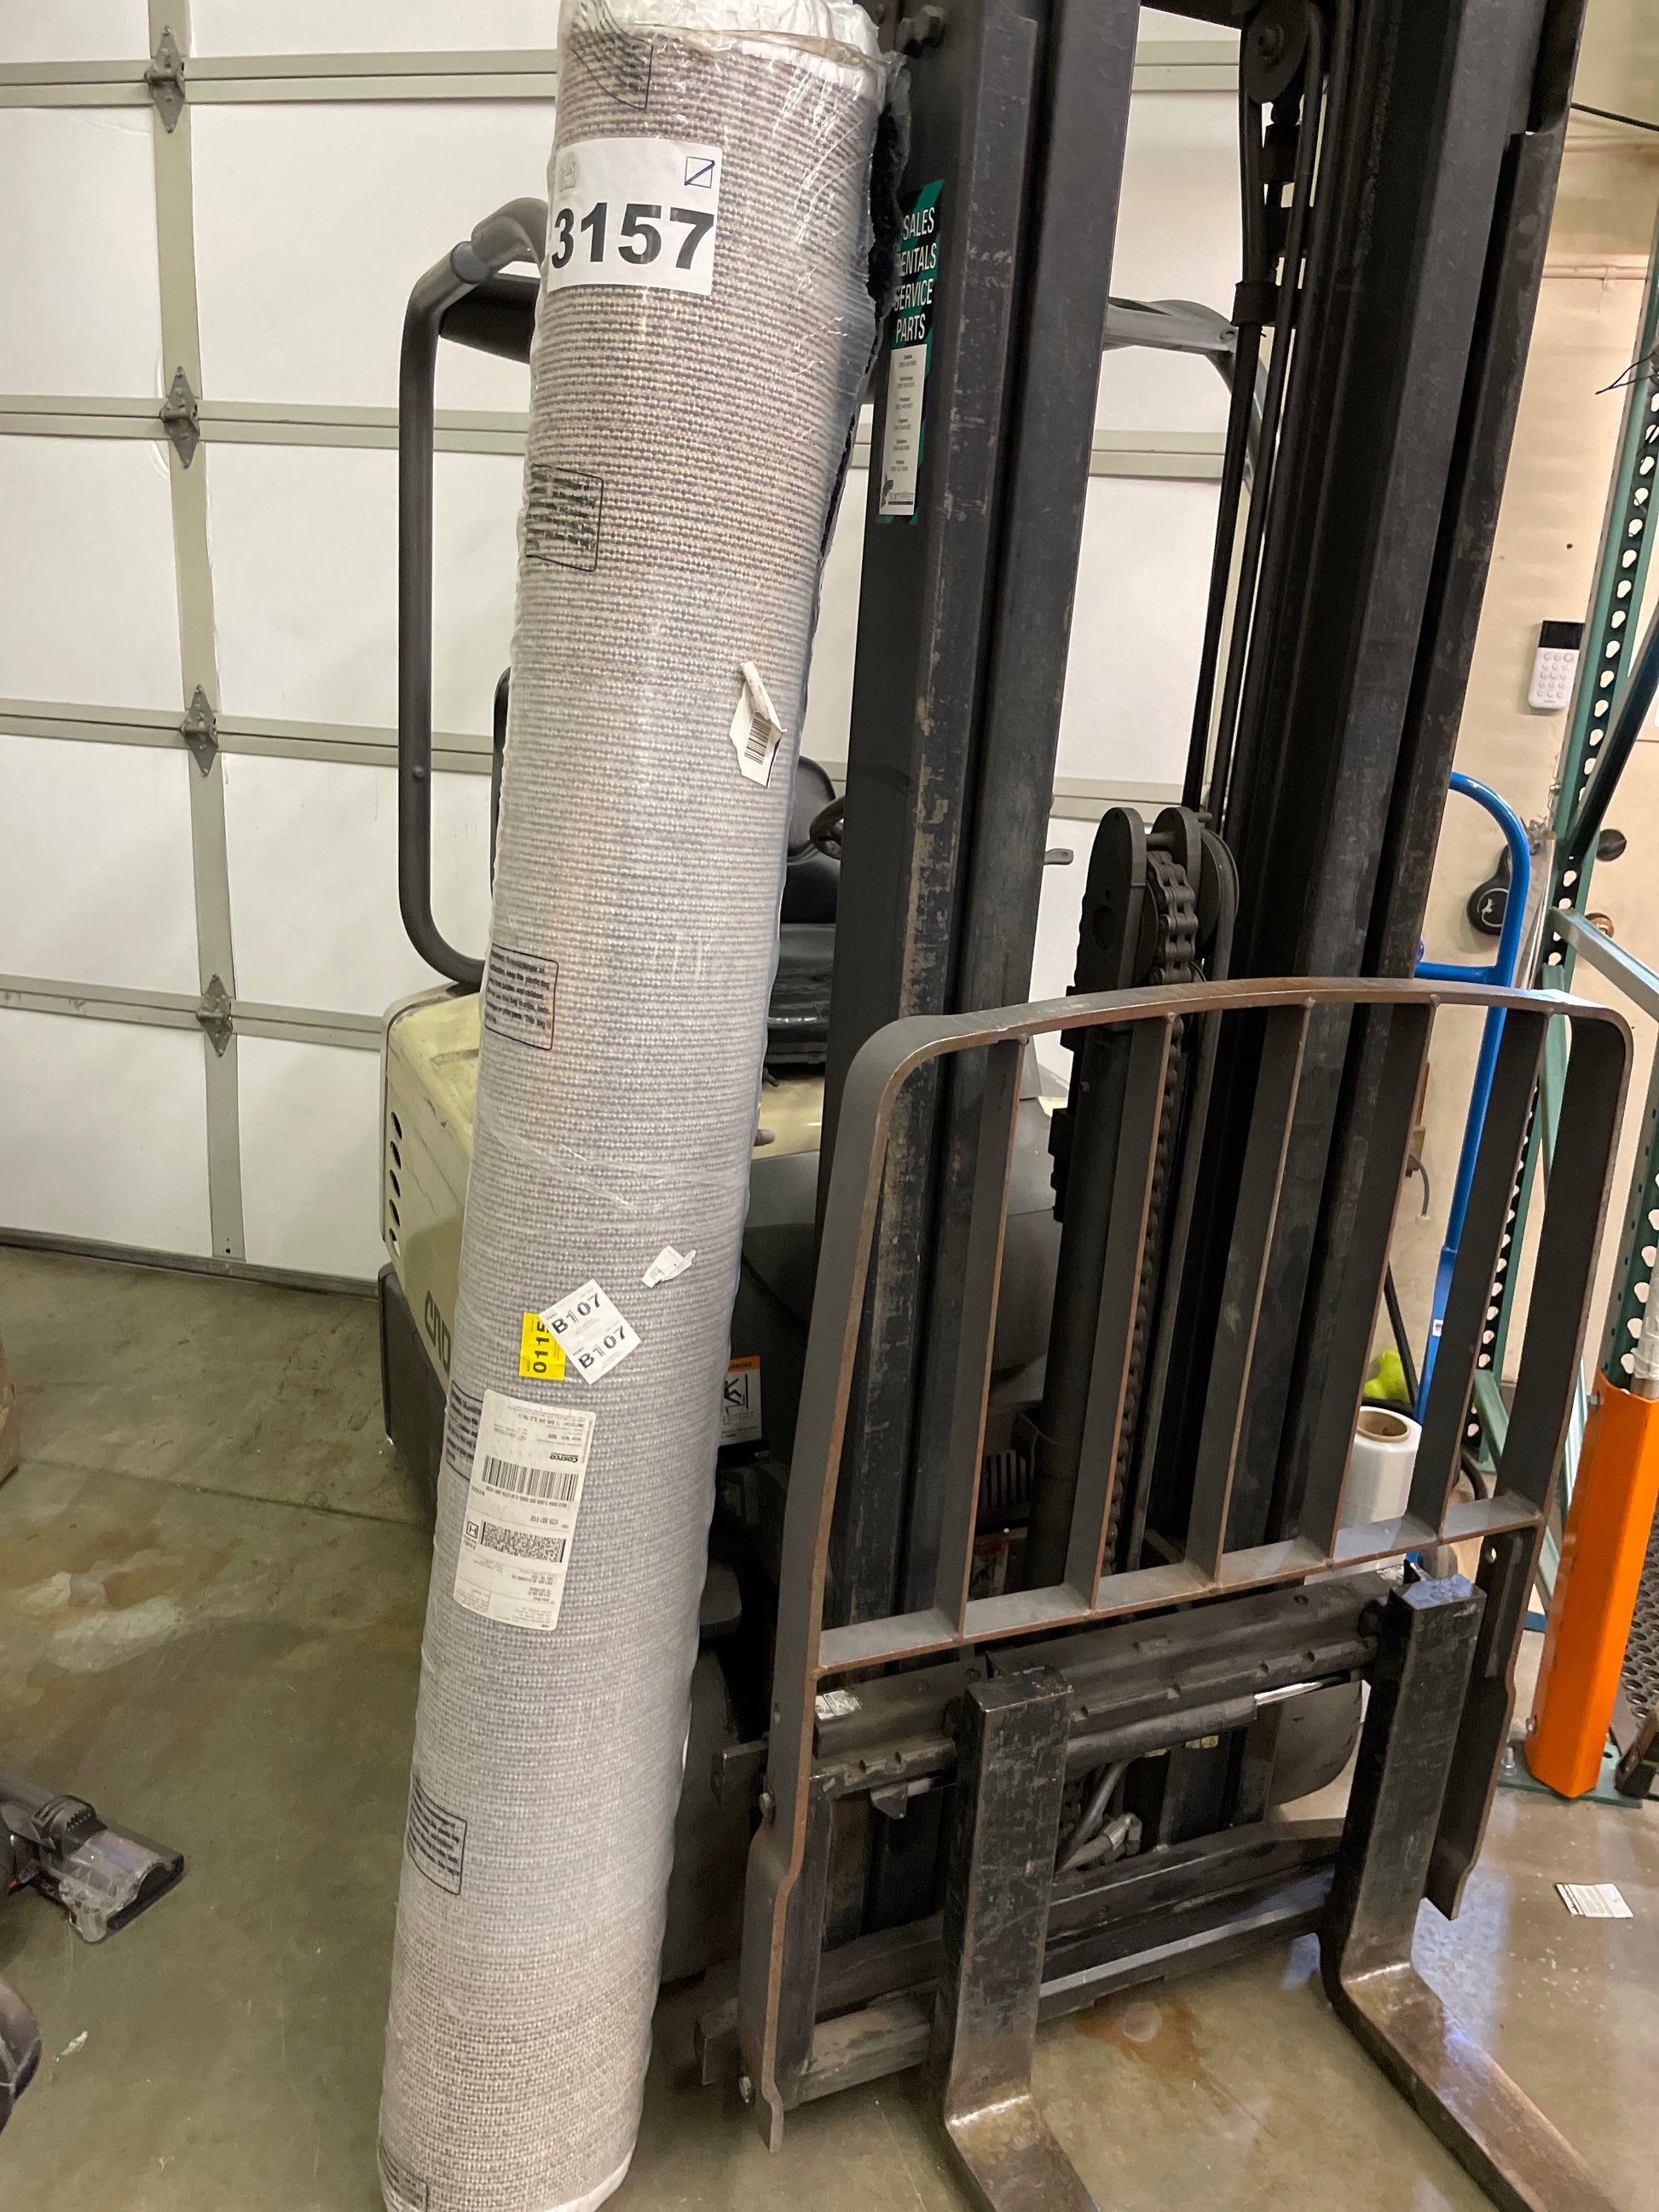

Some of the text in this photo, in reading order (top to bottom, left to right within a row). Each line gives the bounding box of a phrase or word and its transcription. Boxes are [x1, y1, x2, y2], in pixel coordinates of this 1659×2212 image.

[551, 202, 715, 269] 3157
[902, 206, 935, 240] SALES
[899, 243, 937, 277] ENTALS
[894, 278, 934, 312] SERVICE
[895, 313, 926, 344] PARTS
[551, 1293, 600, 1335] B107
[578, 1325, 626, 1369] B107
